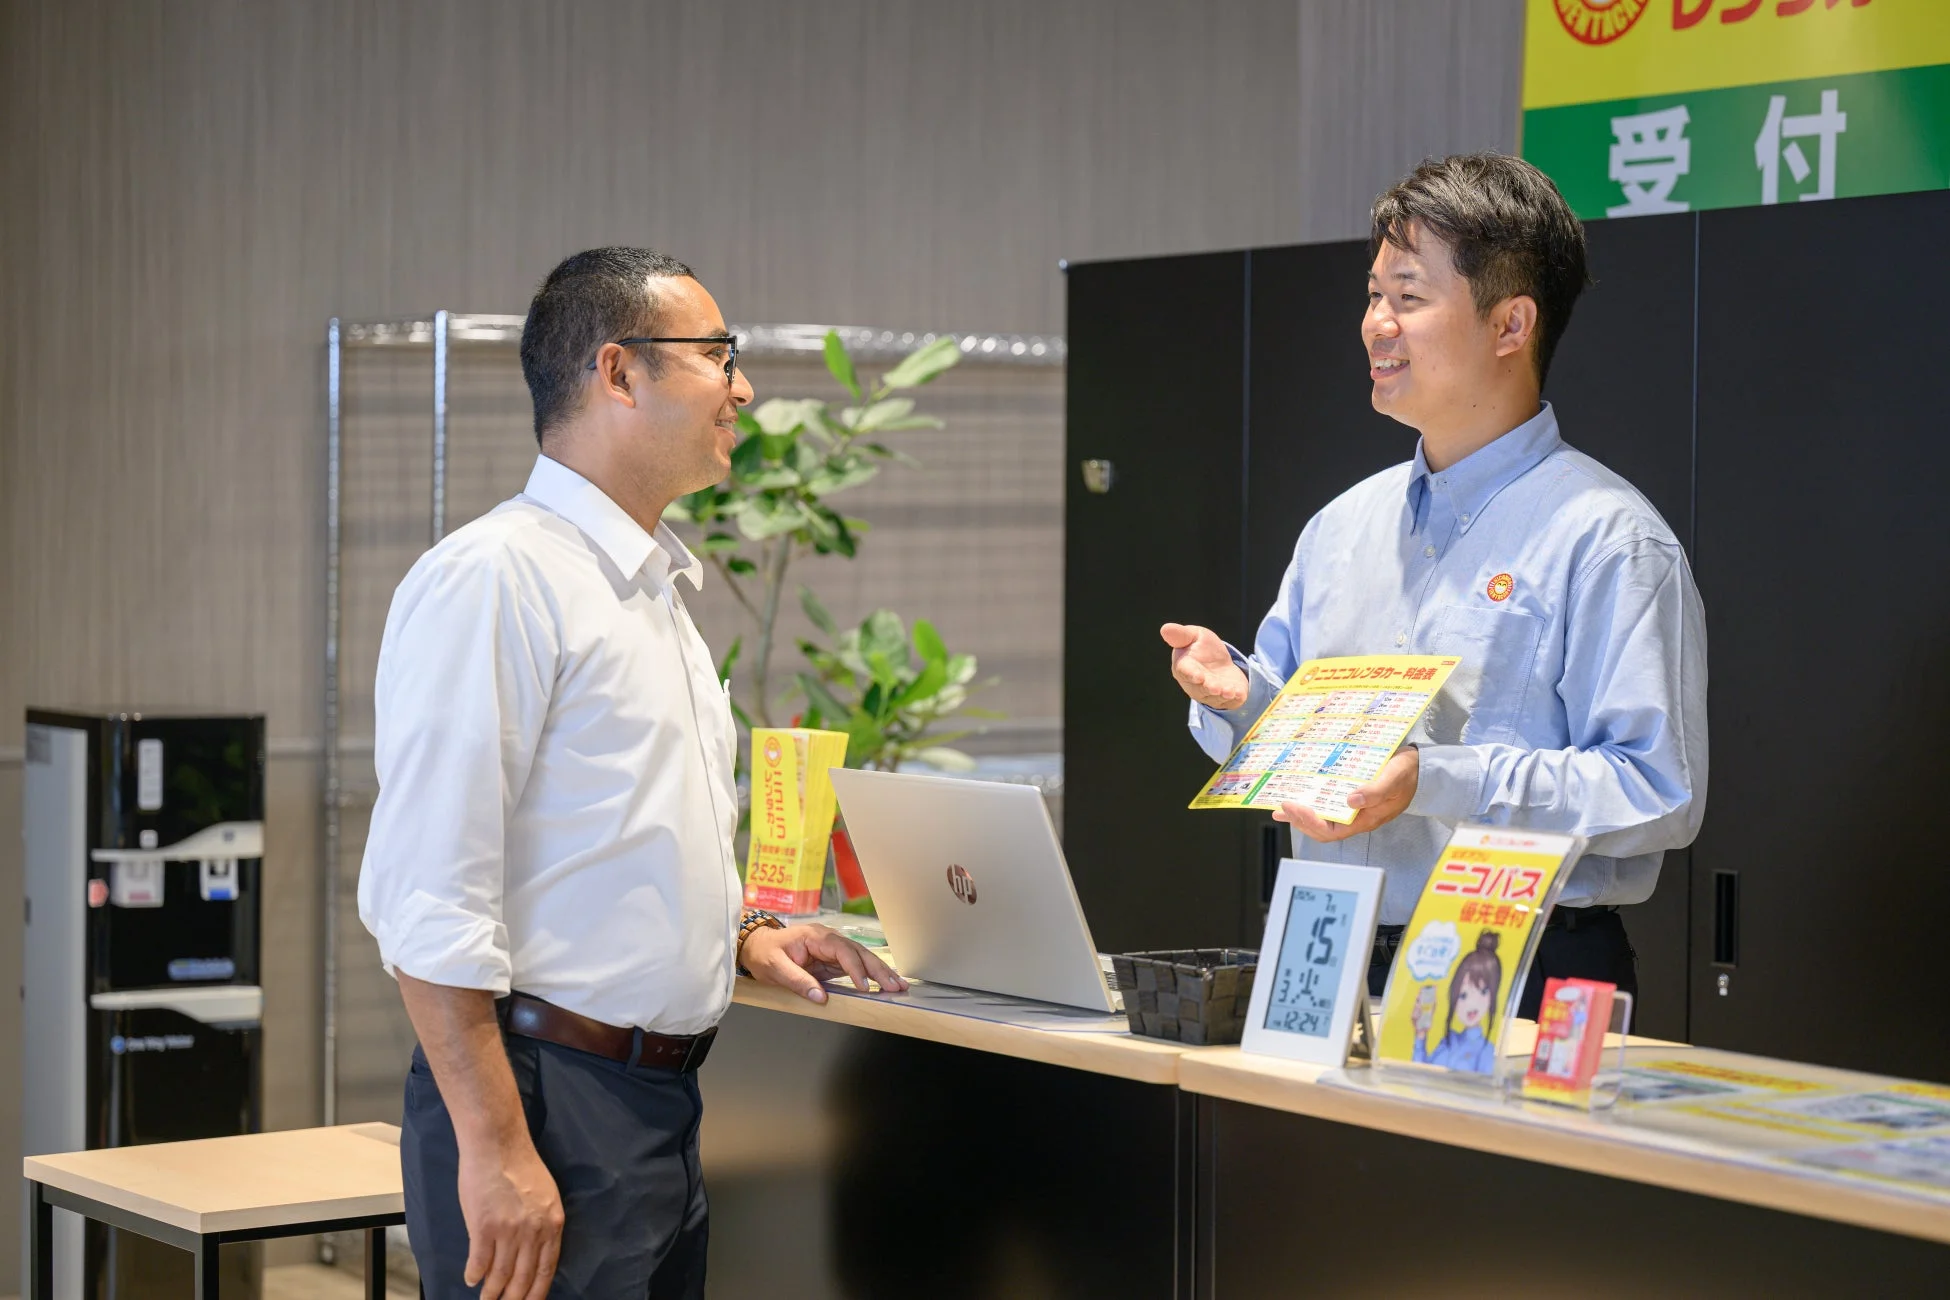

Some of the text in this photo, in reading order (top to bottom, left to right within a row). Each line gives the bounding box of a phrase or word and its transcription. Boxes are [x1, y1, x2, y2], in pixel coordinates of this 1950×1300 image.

[1606, 90, 1847, 219] 受付
[952, 863, 973, 905] hp
[1435, 863, 1543, 899] ニコパス
